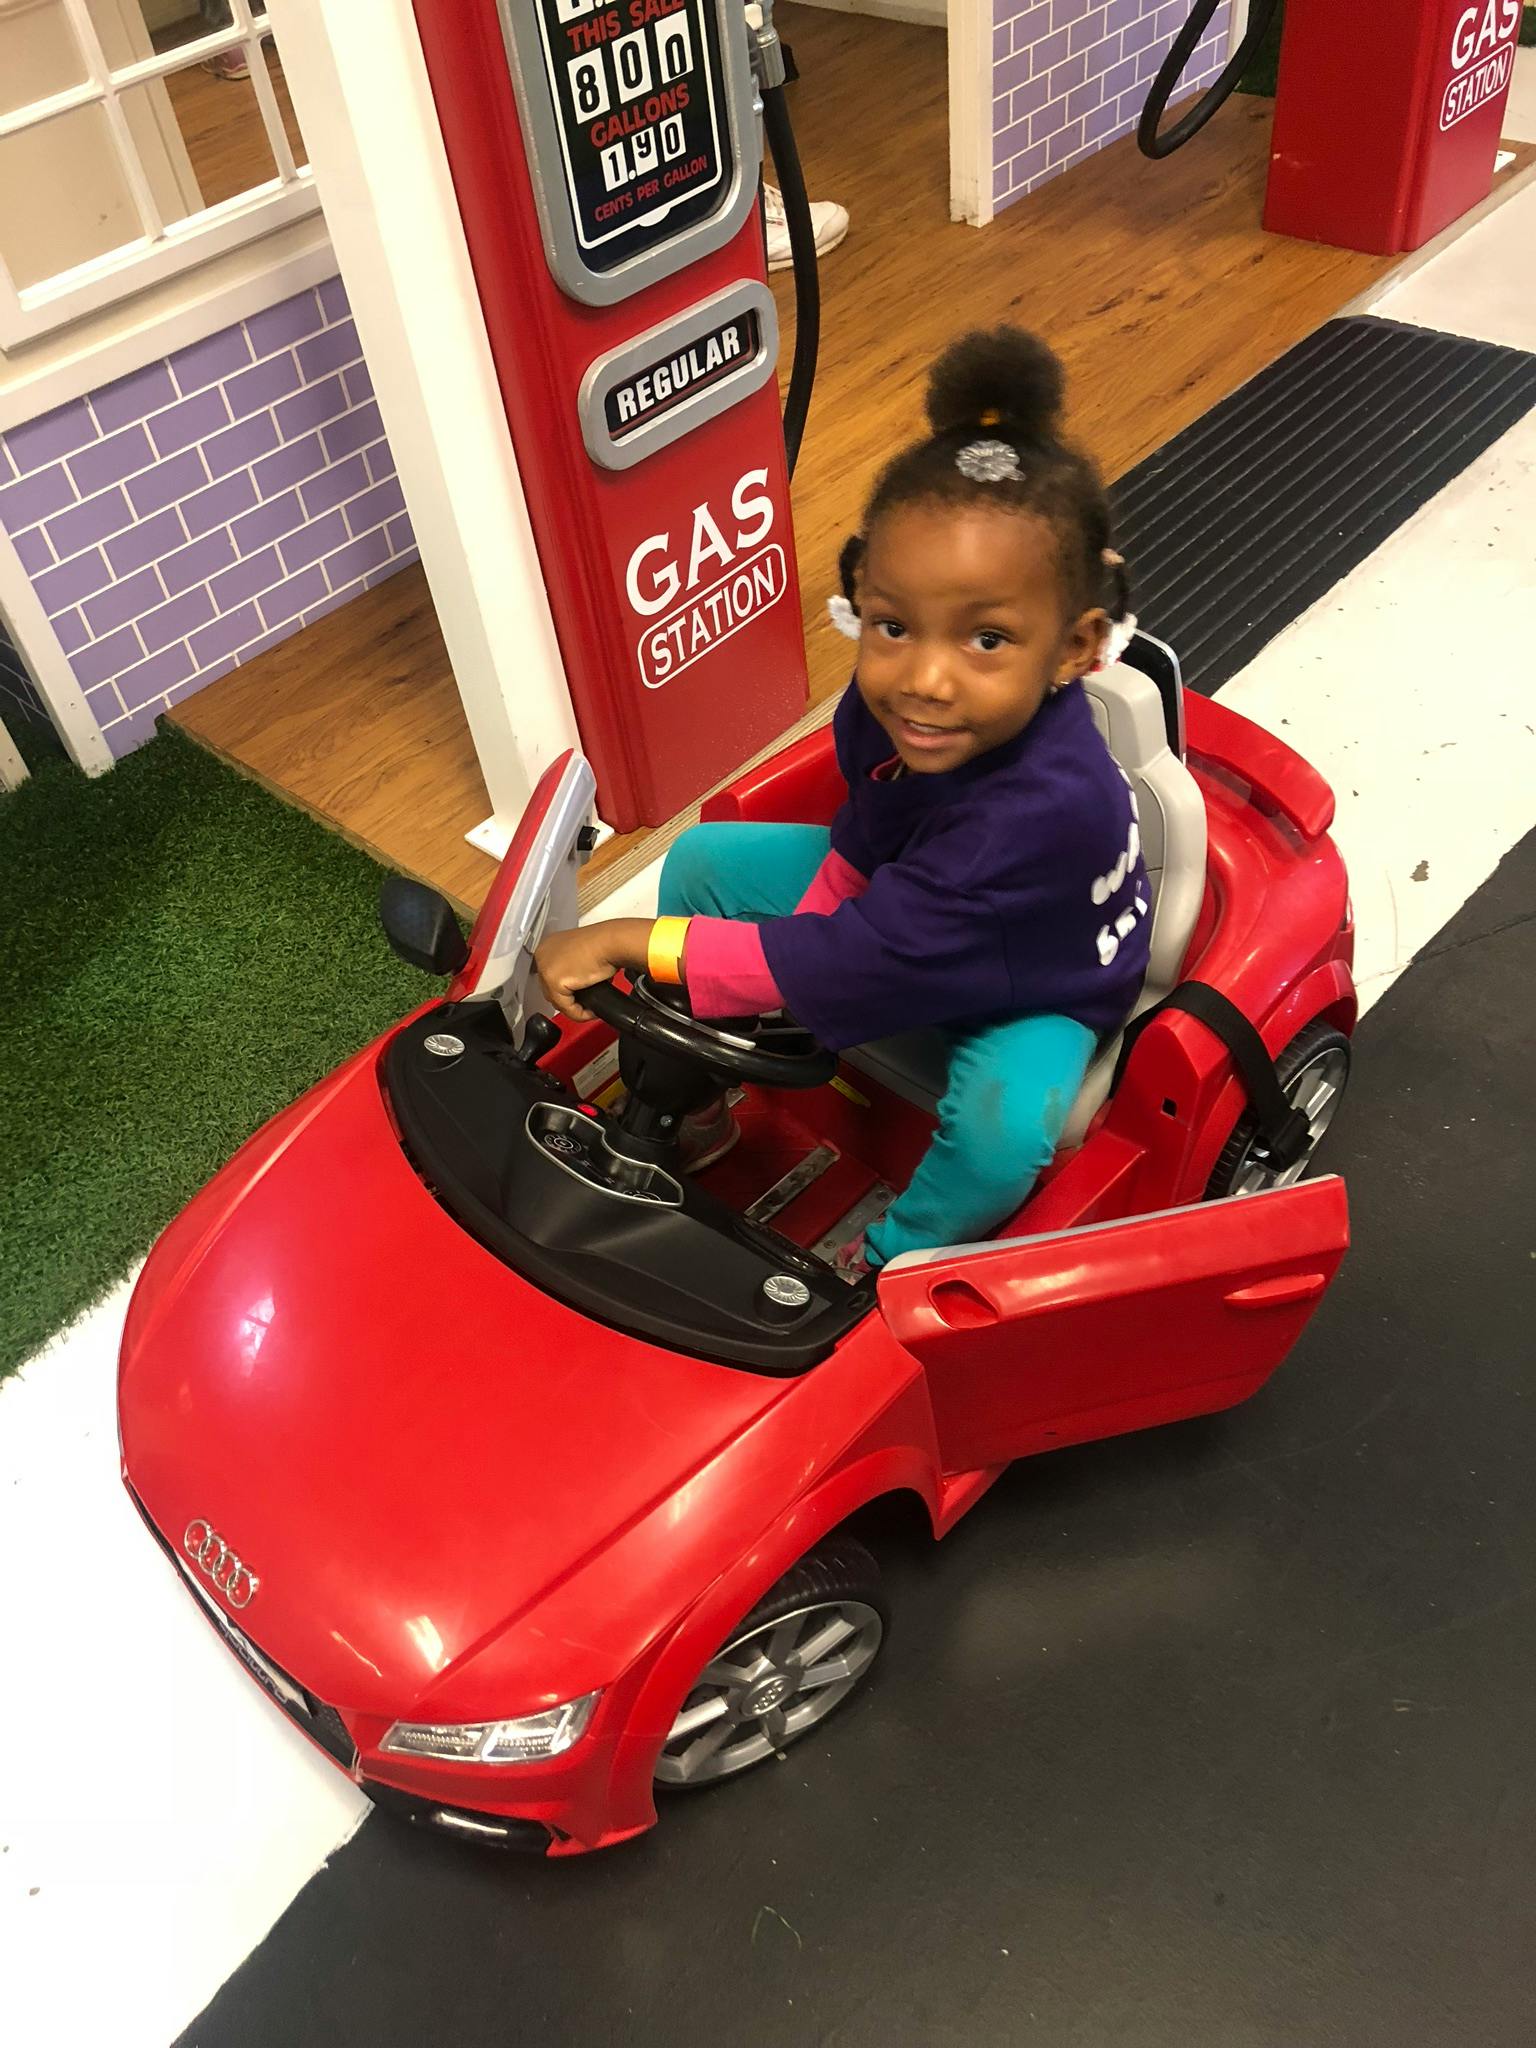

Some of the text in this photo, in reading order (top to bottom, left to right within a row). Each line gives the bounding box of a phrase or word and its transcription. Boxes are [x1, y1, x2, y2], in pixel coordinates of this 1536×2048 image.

[567, 10, 621, 53] THIS
[1451, 0, 1519, 70] GAS
[590, 82, 690, 147] GALLONS
[1446, 51, 1508, 121] STATION
[594, 154, 708, 222] CENTS PER GALLON
[616, 325, 740, 423] REGULAR
[625, 467, 775, 617] GAS
[650, 557, 776, 677] STATION
